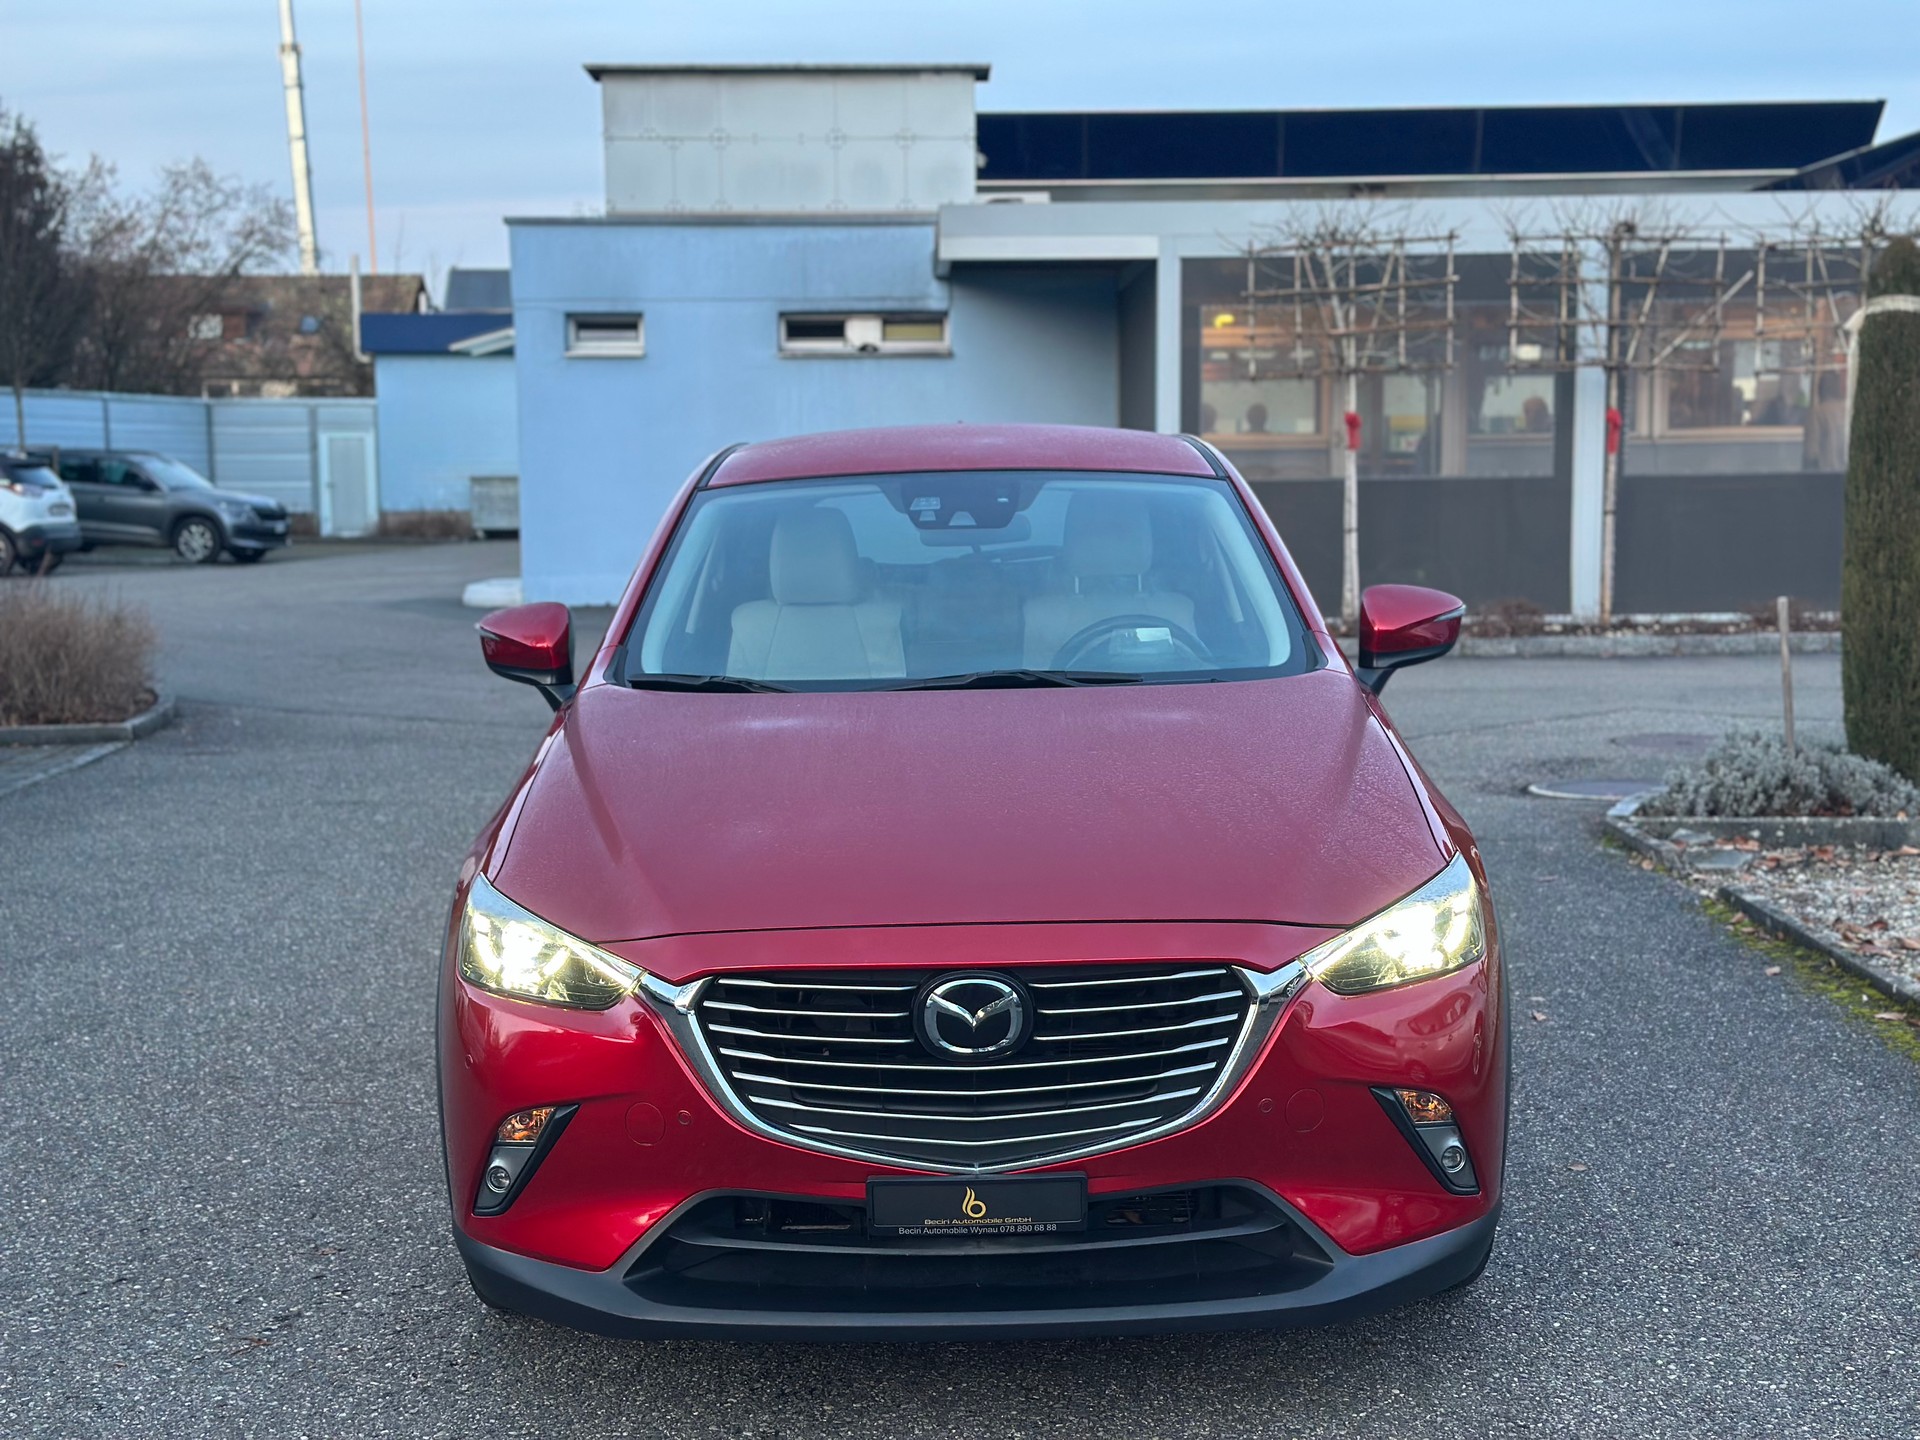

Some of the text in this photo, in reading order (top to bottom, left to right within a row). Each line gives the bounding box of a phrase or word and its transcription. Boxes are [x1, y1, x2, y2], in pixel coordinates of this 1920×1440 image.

[922, 1226, 968, 1235] Automobile
[970, 1225, 999, 1235] Wynau
[999, 1225, 1015, 1233] 078
[1016, 1224, 1033, 1232] 890
[1034, 1224, 1045, 1232] 68
[1046, 1223, 1057, 1231] 88
